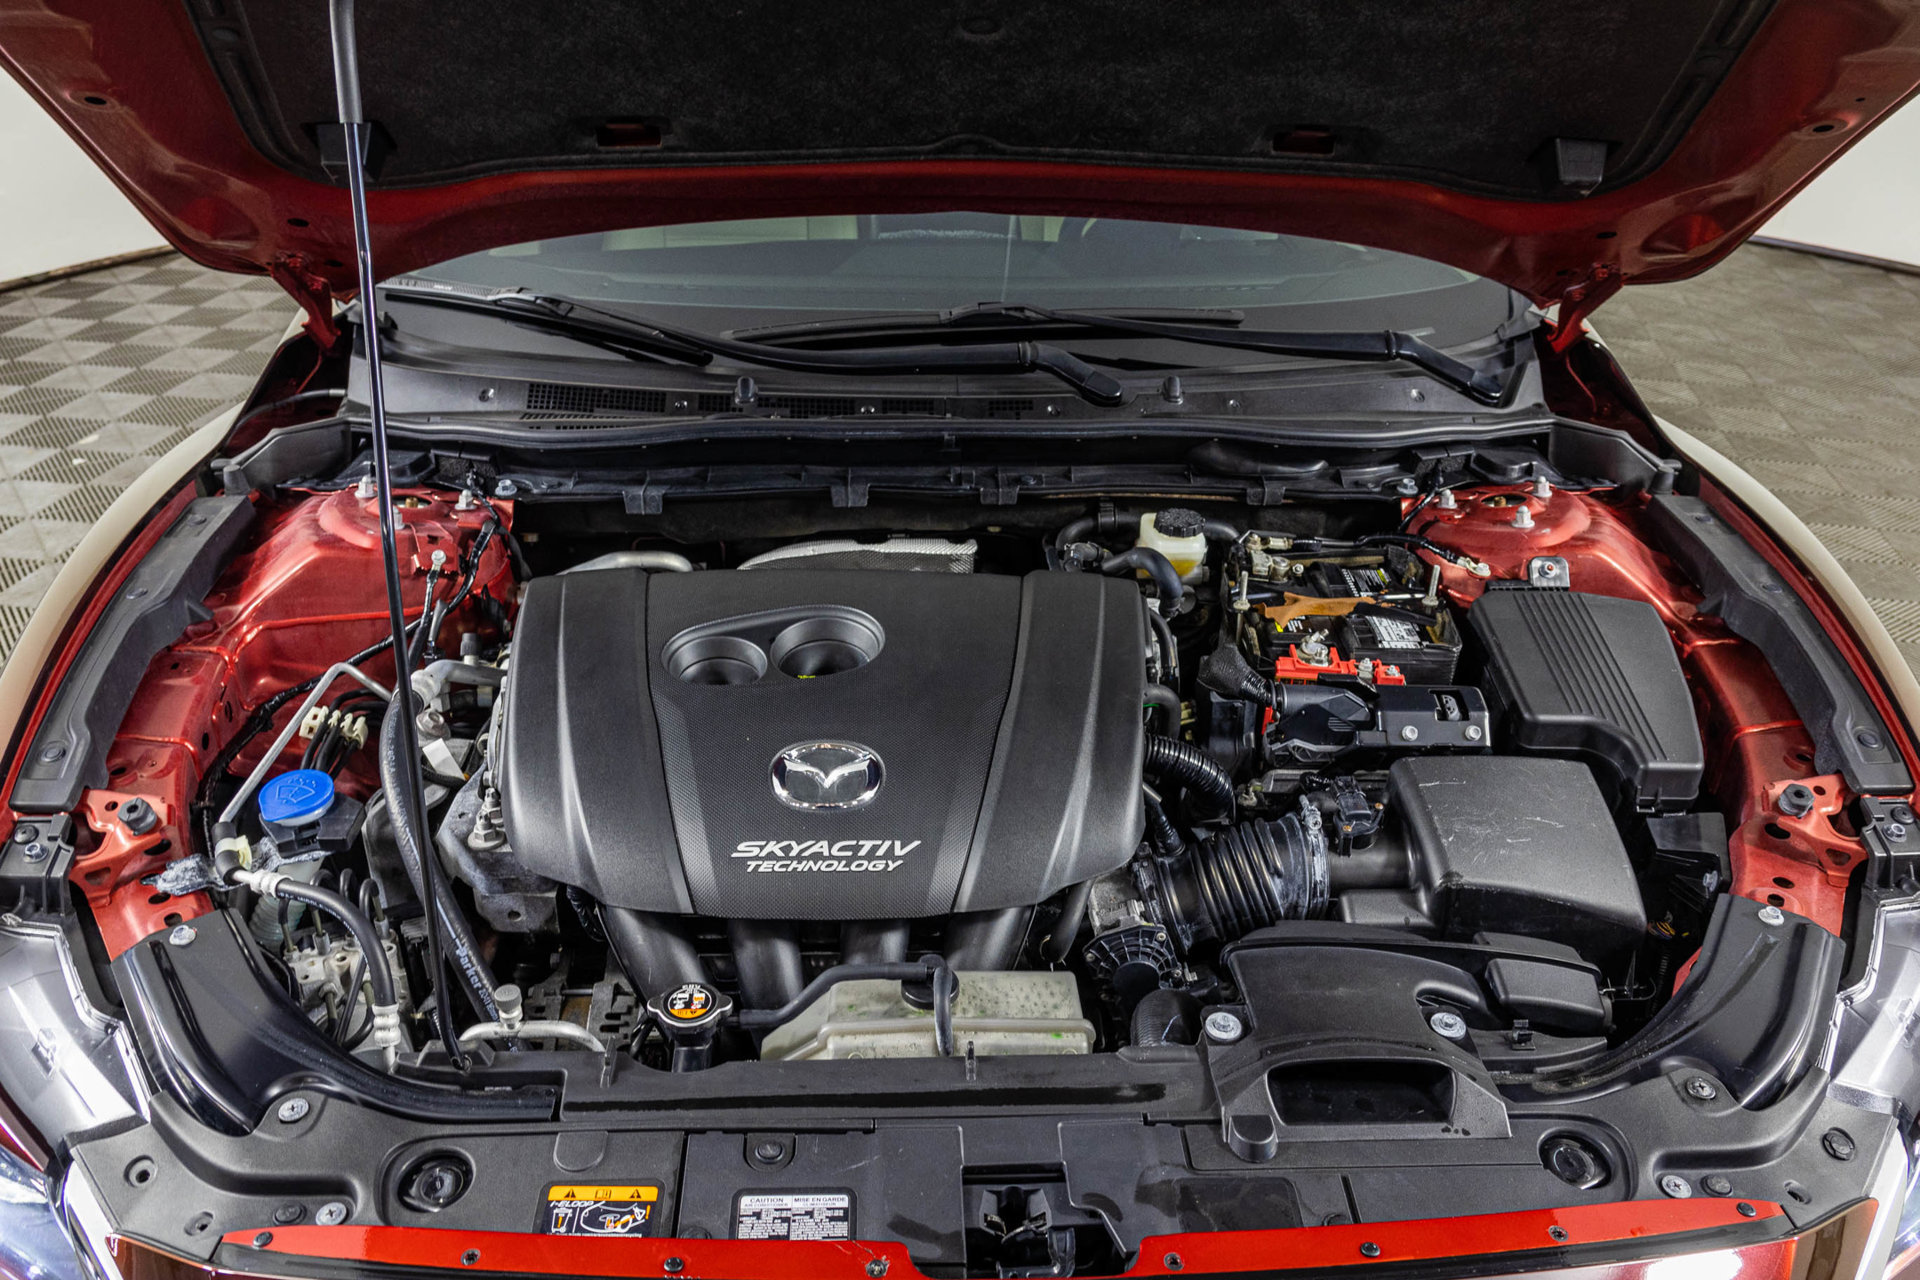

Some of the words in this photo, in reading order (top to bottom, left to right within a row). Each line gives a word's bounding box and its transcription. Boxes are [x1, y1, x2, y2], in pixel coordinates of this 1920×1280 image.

[730, 840, 922, 857] SKYACTIV
[746, 860, 904, 873] TECHNOLOGY
[455, 945, 482, 989] Parker
